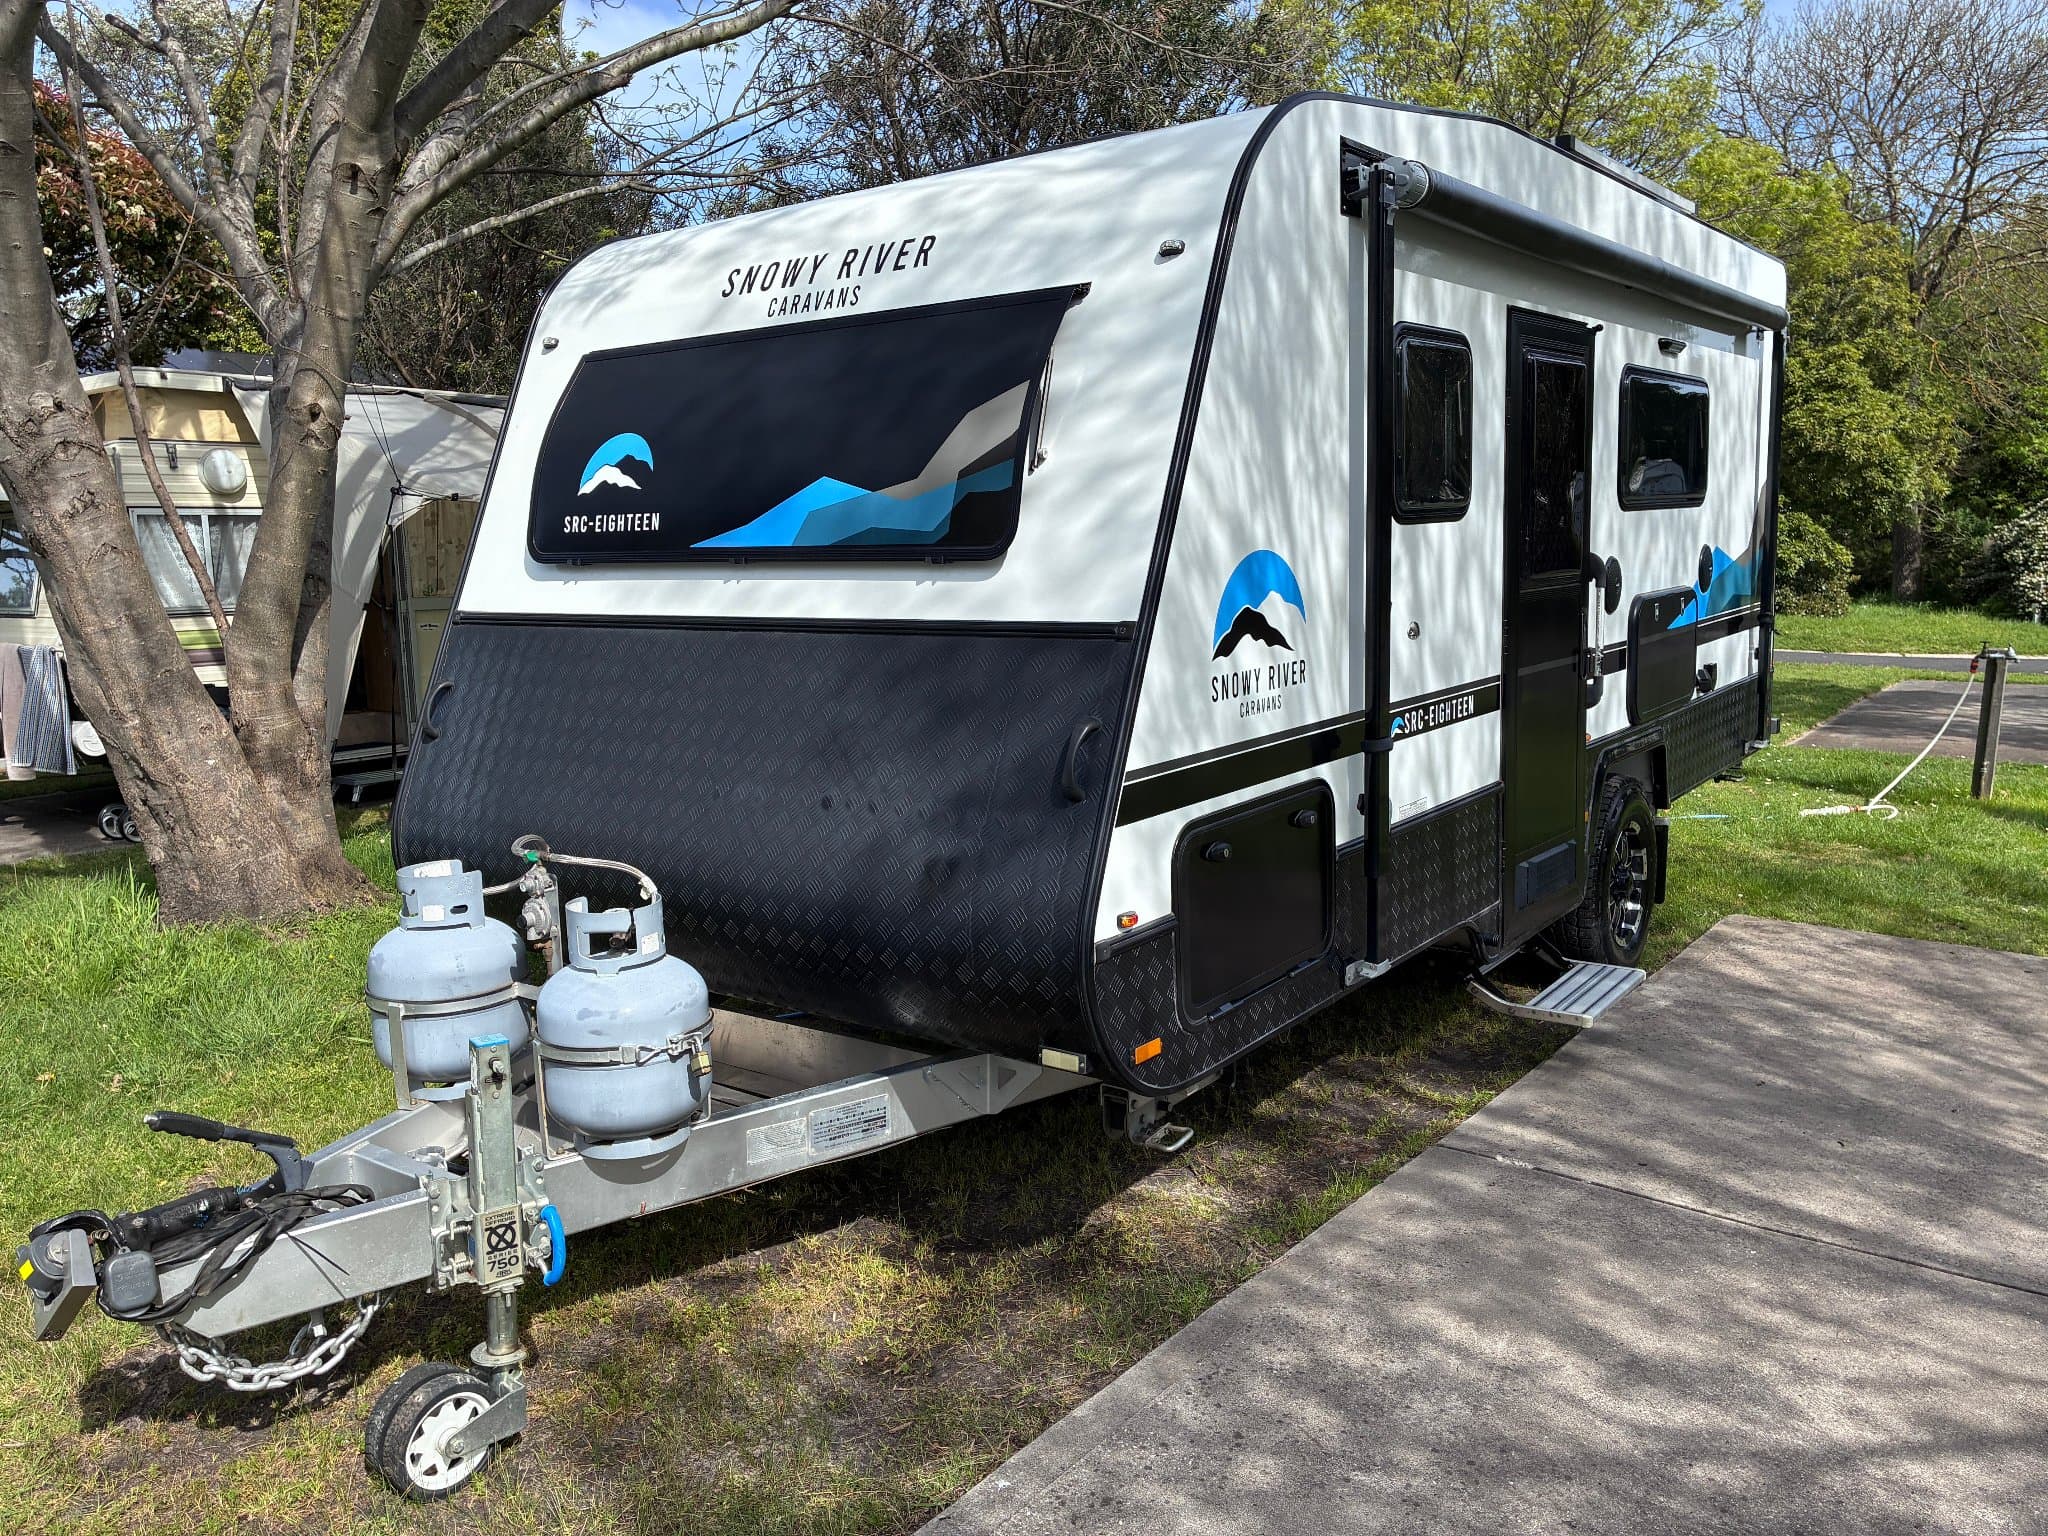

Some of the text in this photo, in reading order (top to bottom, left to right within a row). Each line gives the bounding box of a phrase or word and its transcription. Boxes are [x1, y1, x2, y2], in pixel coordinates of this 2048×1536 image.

[722, 235, 937, 298] SNOWY RIVER
[767, 284, 862, 318] CARAVANS
[563, 512, 660, 533] SRC-EIGHTEEN
[1211, 659, 1306, 703] SNOWY RIVER
[1239, 694, 1282, 718] CARAVANS
[1404, 694, 1475, 734] SRC-EIGHTEEN
[485, 1210, 515, 1221] EXTREME
[486, 1255, 520, 1272] 750
[487, 1249, 518, 1261] SERIES
